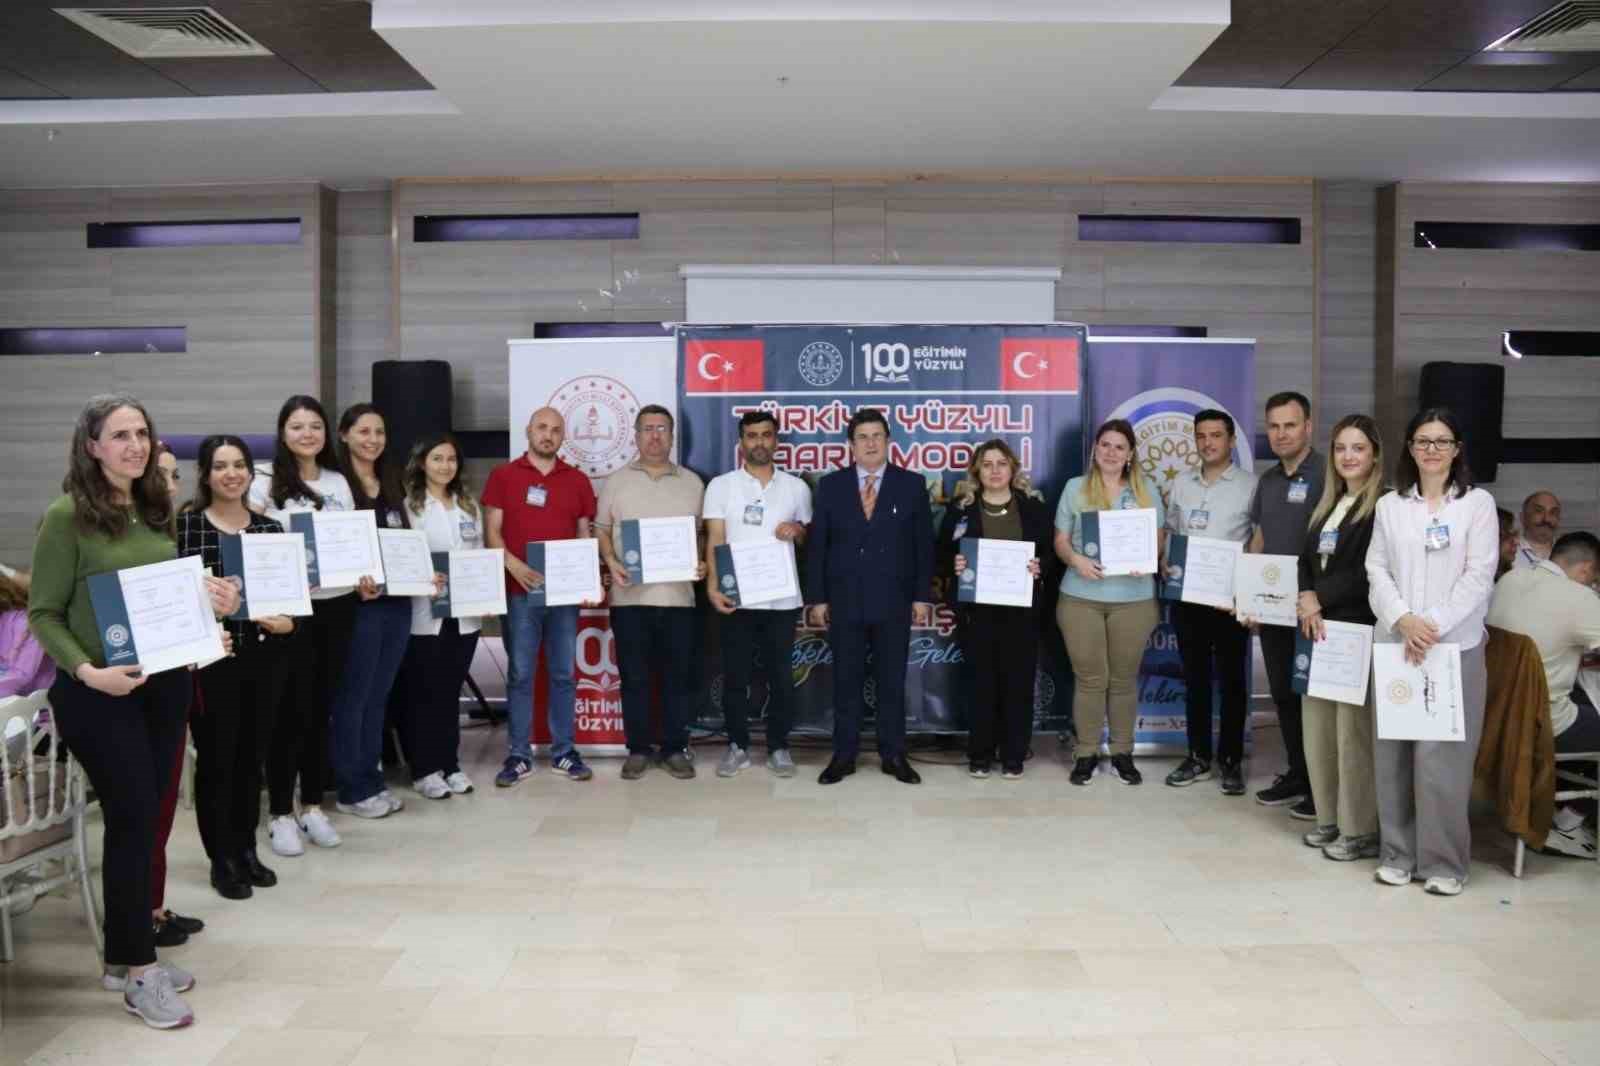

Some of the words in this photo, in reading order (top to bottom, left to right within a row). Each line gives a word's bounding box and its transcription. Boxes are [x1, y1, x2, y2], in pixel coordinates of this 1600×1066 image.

[861, 341, 910, 382] 100
[912, 346, 967, 358] EĞİTİMİN
[914, 358, 964, 370] YÜZYILI
[895, 400, 1032, 433] YÜZYILI
[888, 436, 1032, 471] MODİ
